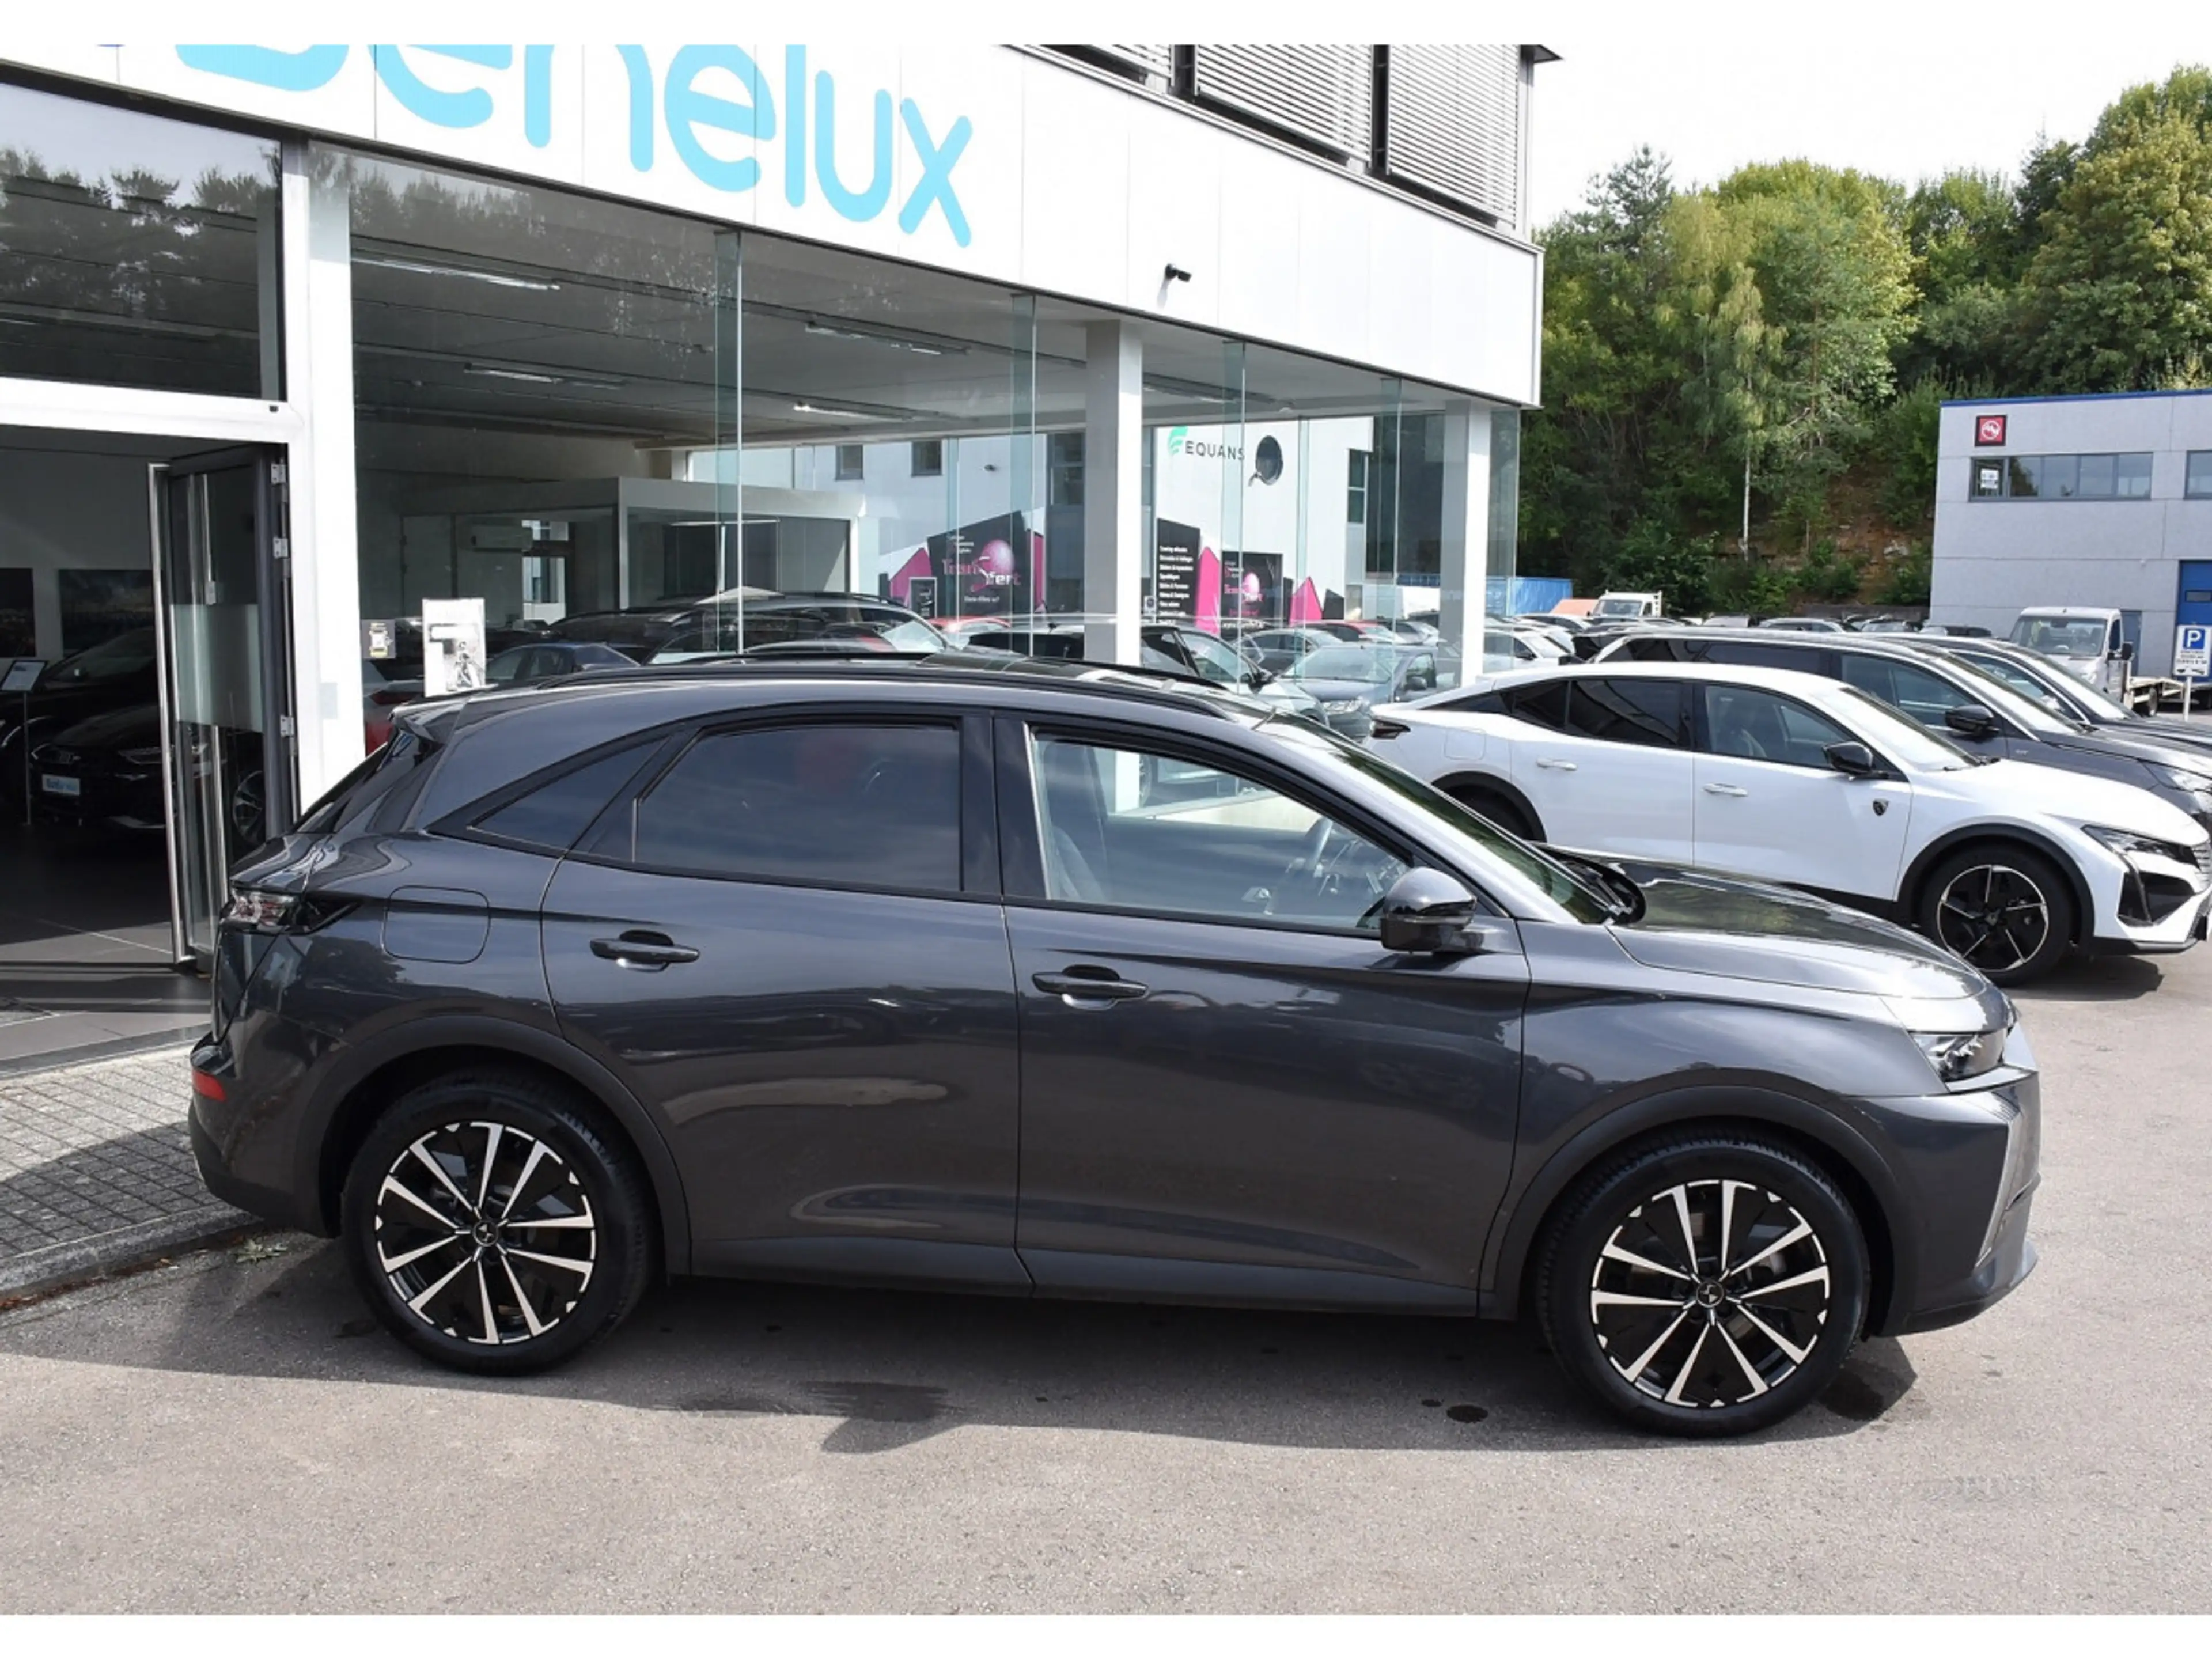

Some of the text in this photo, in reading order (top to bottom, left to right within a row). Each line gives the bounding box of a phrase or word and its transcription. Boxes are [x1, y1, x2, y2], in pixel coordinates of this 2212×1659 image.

[175, 44, 972, 248] nelux
[1185, 440, 1244, 461] EQUANS
[2187, 630, 2202, 648] P
